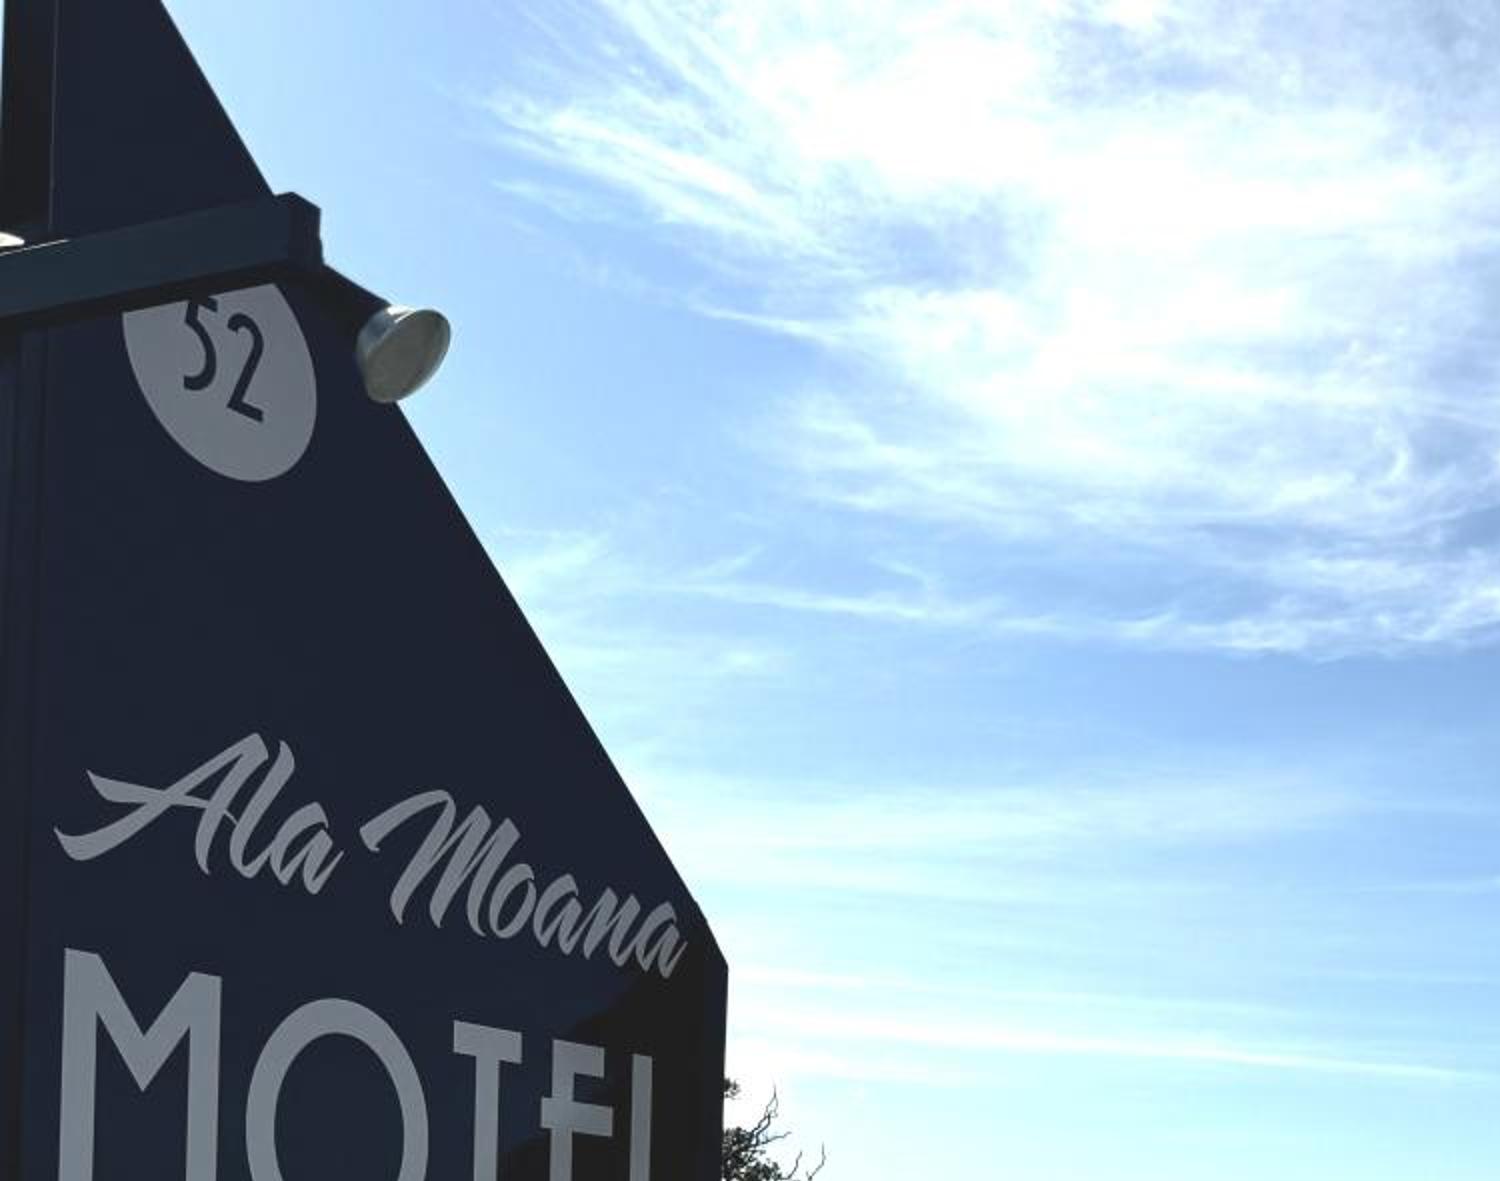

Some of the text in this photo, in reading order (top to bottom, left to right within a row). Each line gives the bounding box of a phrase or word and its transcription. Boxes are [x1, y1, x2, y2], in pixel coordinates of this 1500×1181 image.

[184, 297, 265, 423] 52
[54, 732, 688, 979] Ala Moana
